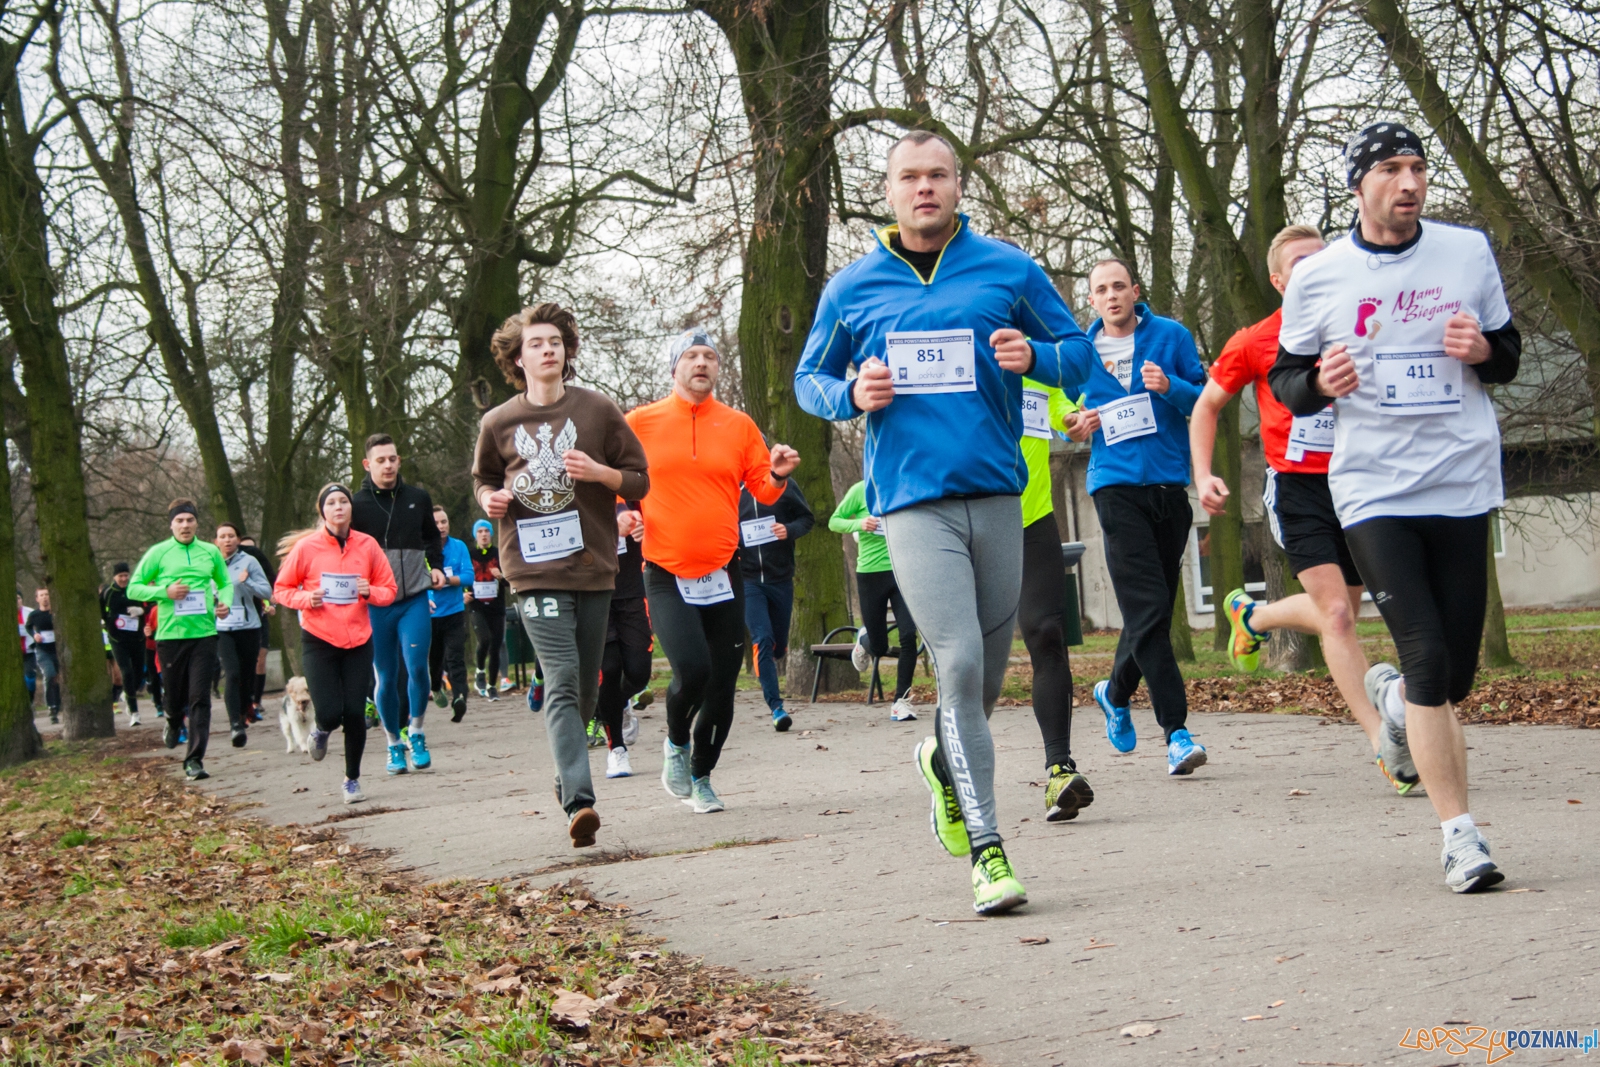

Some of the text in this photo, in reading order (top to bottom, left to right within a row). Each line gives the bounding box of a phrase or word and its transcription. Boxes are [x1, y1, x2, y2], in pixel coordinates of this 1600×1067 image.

[1391, 286, 1443, 316] Mamy
[1401, 300, 1462, 323] Biegamy
[918, 349, 945, 362] 851
[918, 367, 946, 380] parkrun
[1406, 364, 1435, 379] 411
[1407, 384, 1436, 398] parkrun
[1117, 407, 1135, 420] 825
[1314, 419, 1334, 429] 249
[517, 477, 526, 487] A
[540, 527, 560, 538] 137
[753, 524, 766, 532] 736
[523, 596, 559, 618] 42
